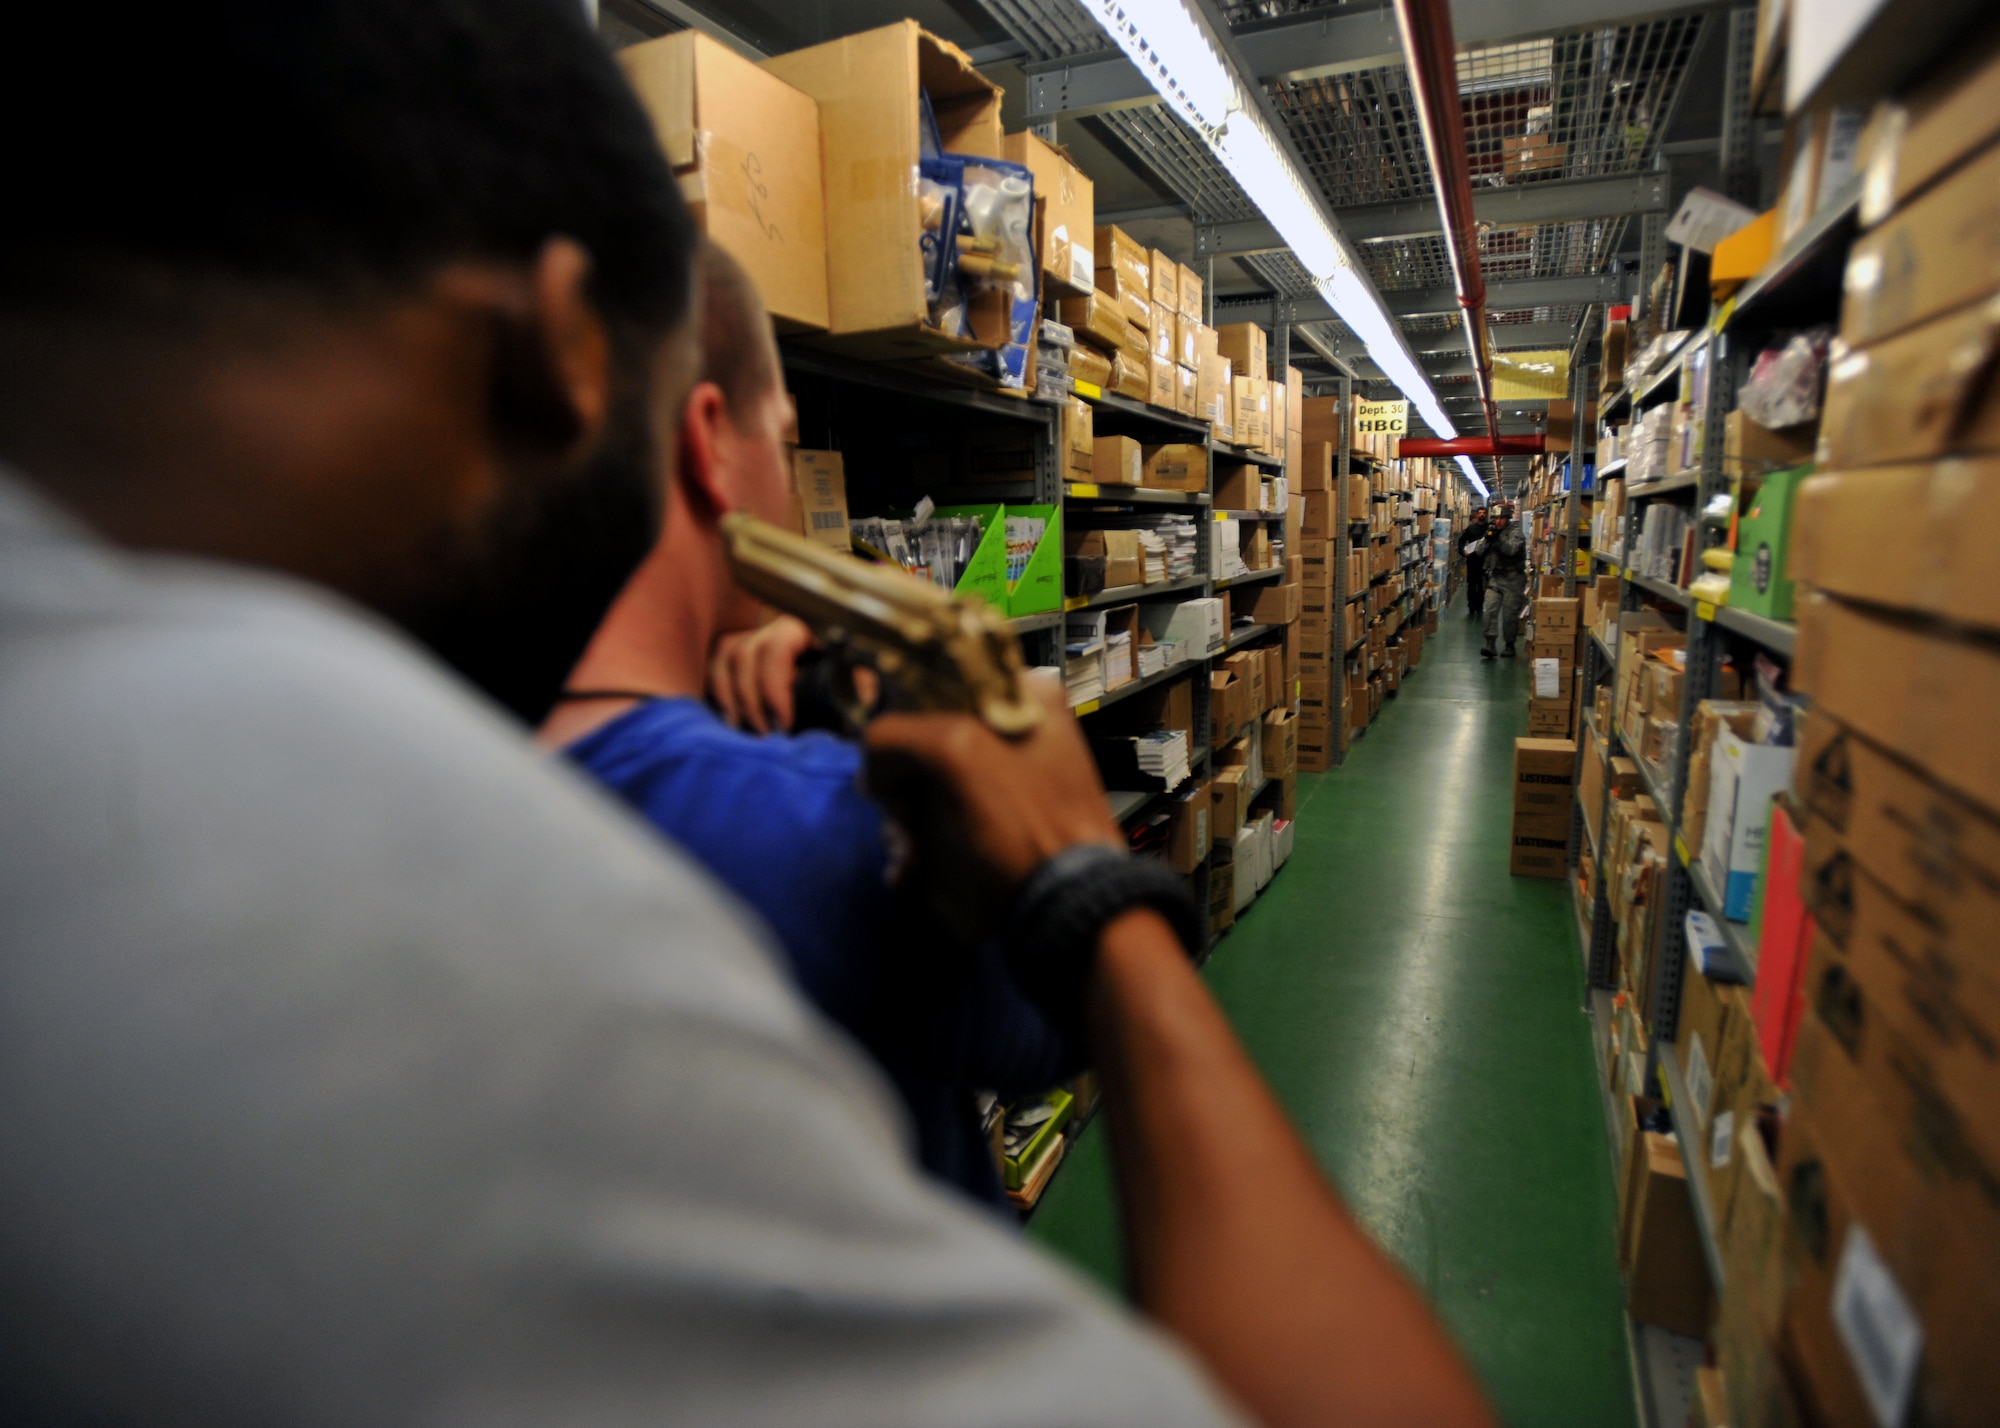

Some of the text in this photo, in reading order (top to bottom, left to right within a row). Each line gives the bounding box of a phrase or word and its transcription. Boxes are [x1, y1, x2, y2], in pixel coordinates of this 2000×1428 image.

[1359, 404, 1404, 416] Dept. 30
[1359, 418, 1403, 432] HBC
[1302, 557, 1325, 565] TERINE
[1302, 604, 1325, 613] TERINE
[1299, 651, 1324, 660] TERINE
[1299, 698, 1323, 707] TERINE
[1519, 772, 1573, 786] LISTERINE
[1515, 835, 1568, 850] LISTERINE
